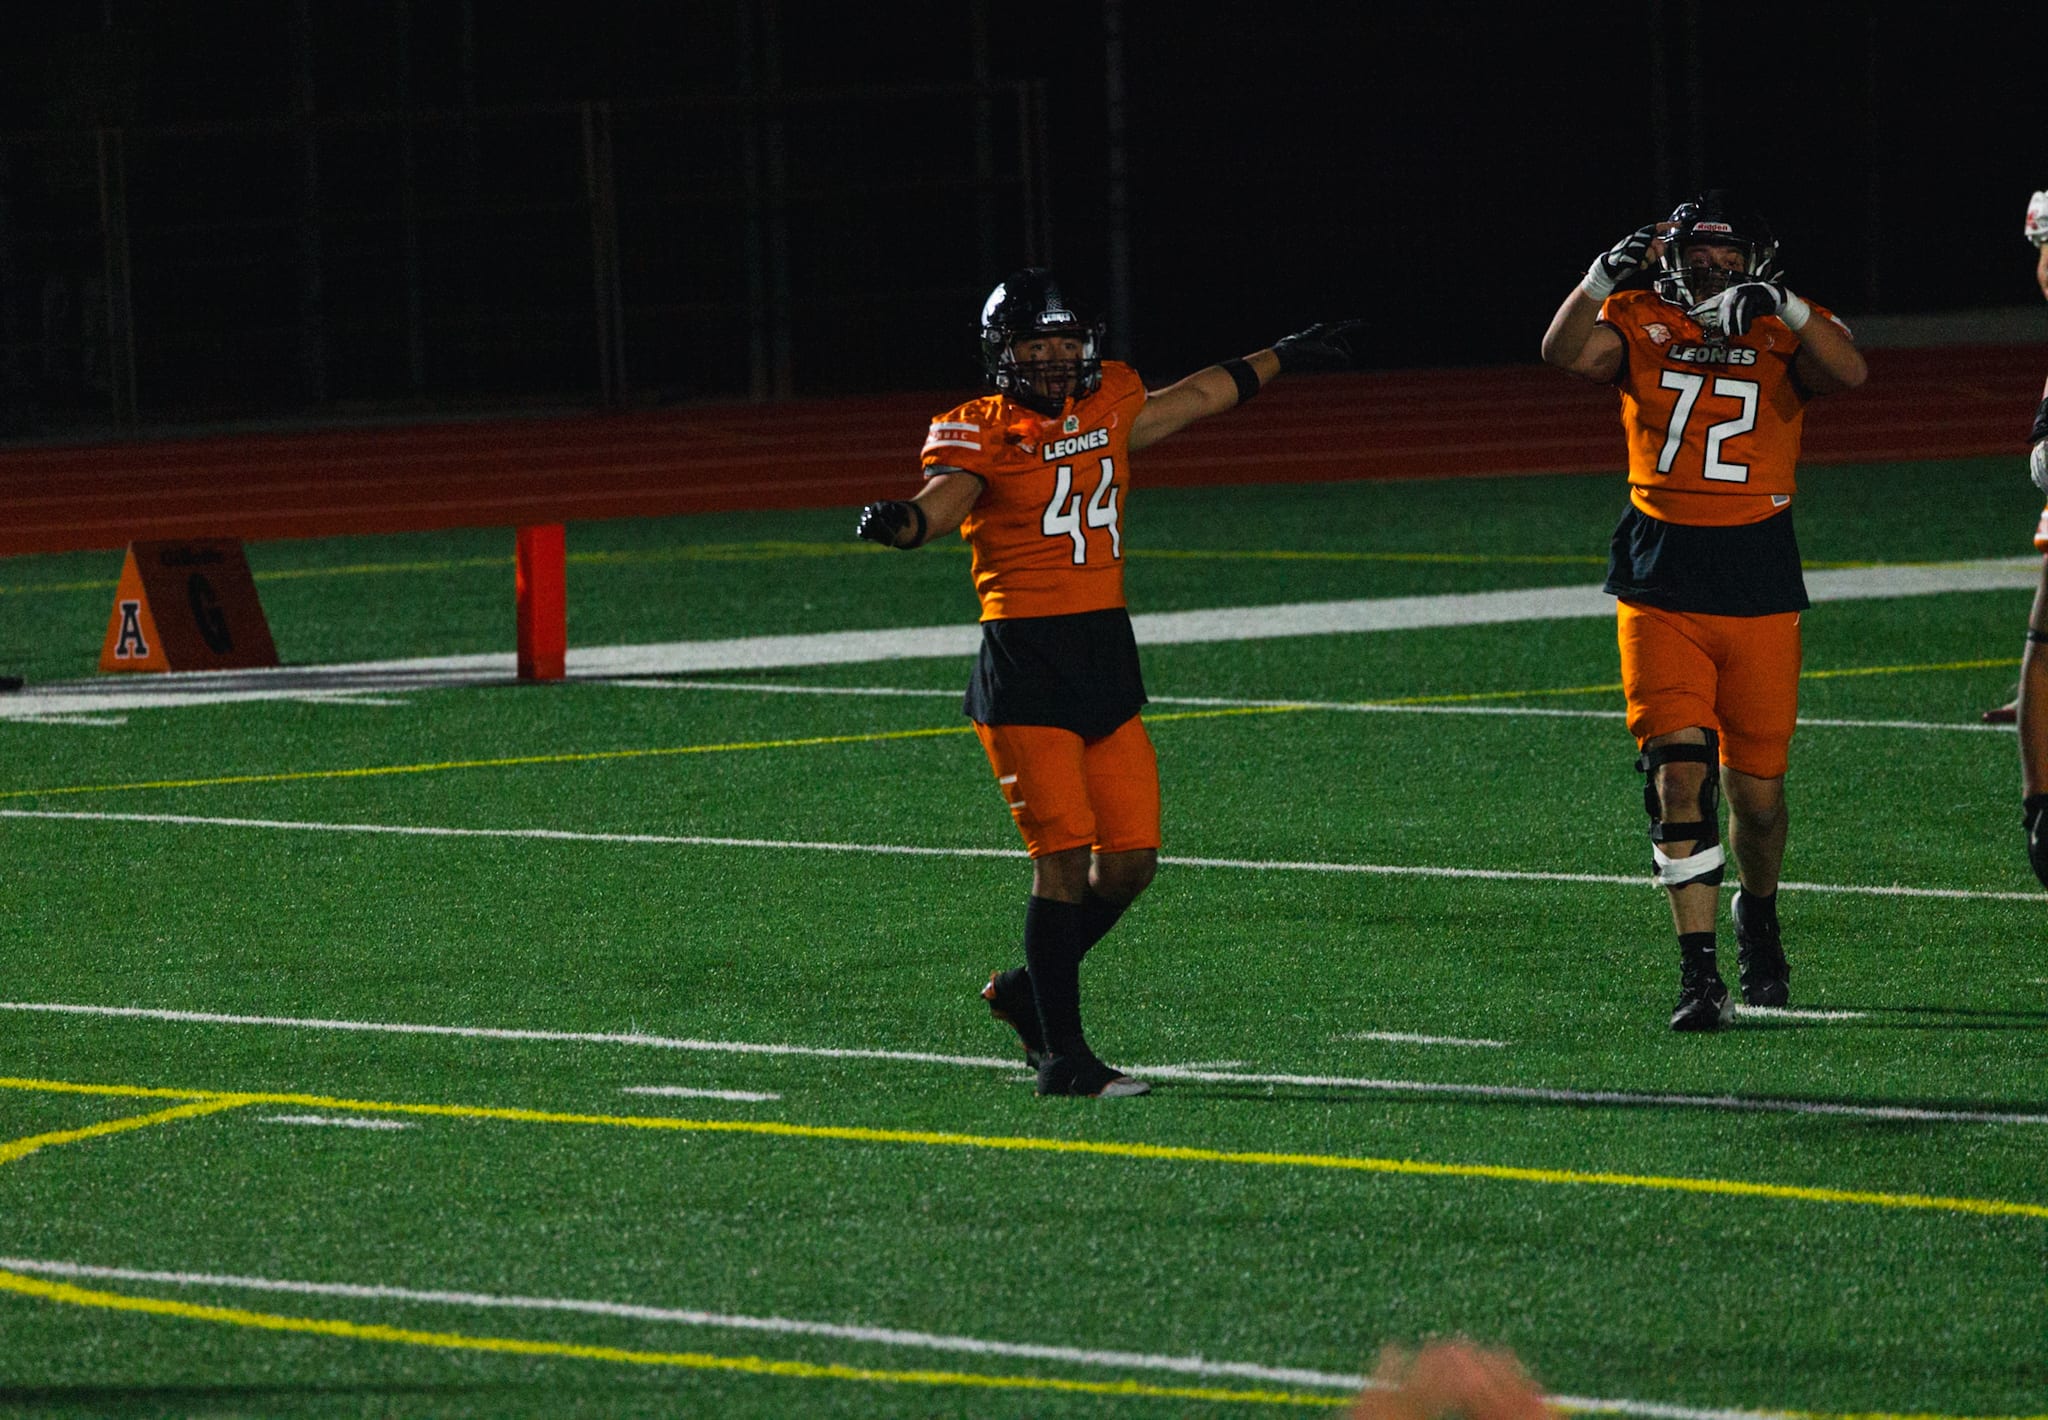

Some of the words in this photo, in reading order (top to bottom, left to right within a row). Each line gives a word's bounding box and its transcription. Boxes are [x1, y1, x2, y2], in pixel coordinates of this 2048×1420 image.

[1668, 344, 1757, 366] LEONES
[1043, 427, 1109, 461] LEONES
[1656, 368, 1760, 483] 72
[1042, 456, 1121, 565] 44
[115, 600, 149, 660] A
[188, 572, 234, 656] G
